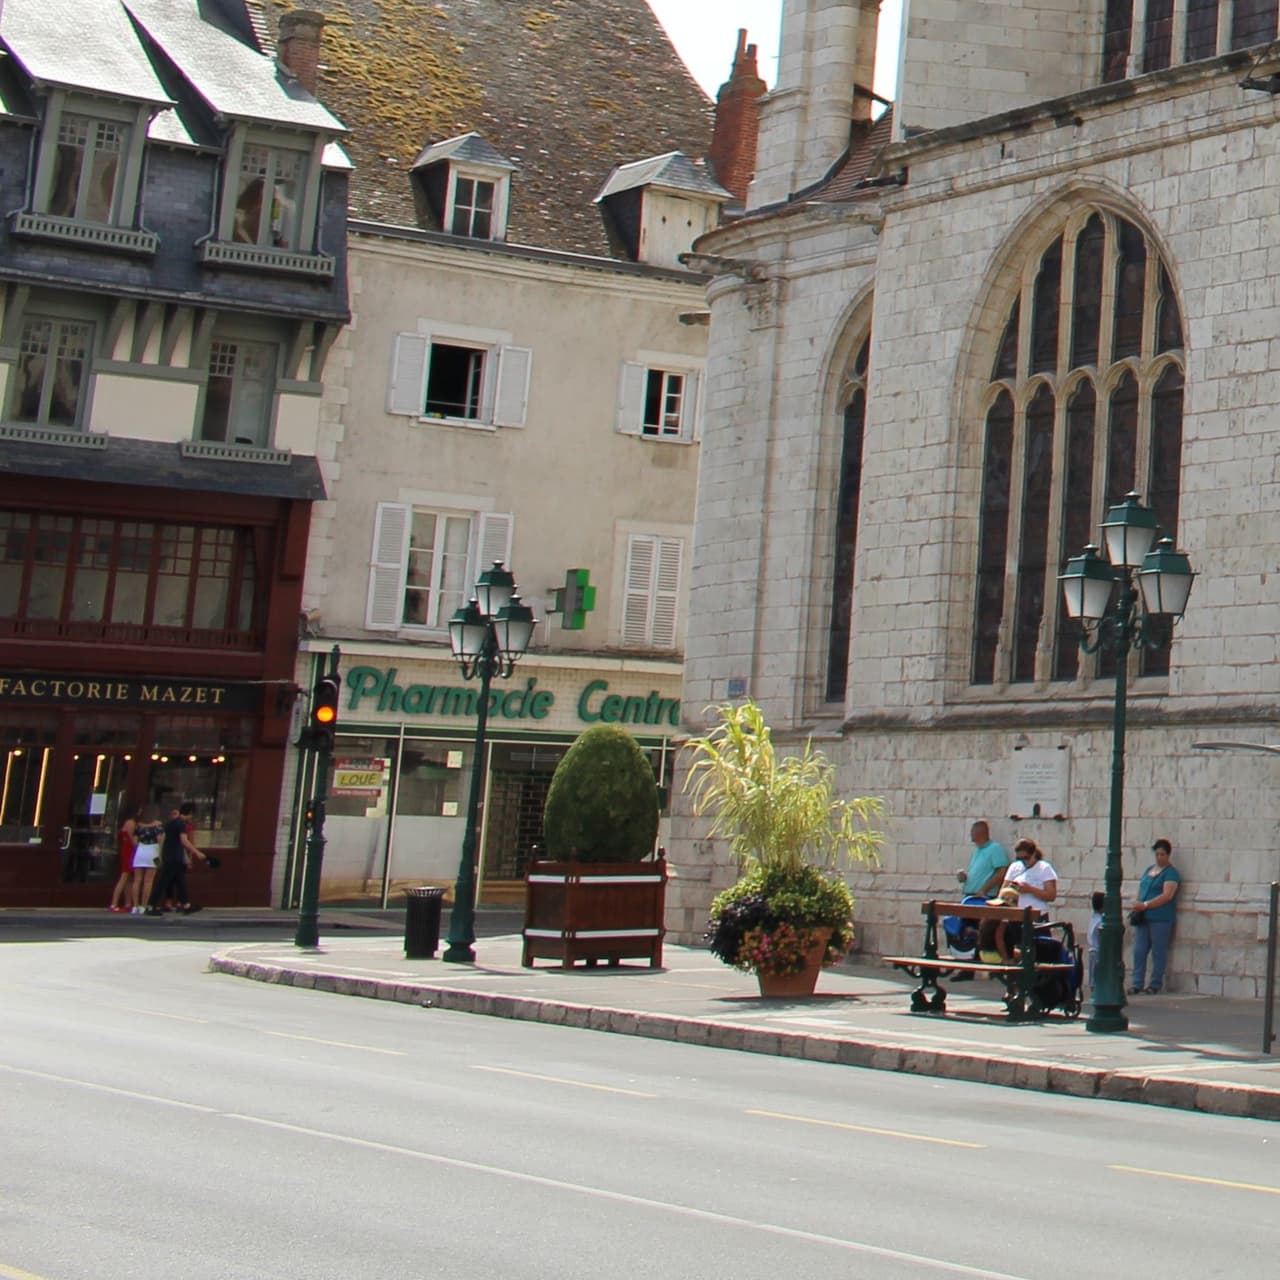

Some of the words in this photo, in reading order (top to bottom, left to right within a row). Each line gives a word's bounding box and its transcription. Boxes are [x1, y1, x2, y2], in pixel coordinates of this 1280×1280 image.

[0, 678, 129, 700] FACTORIE
[140, 685, 226, 704] MAZET
[340, 772, 378, 785] LOUE
